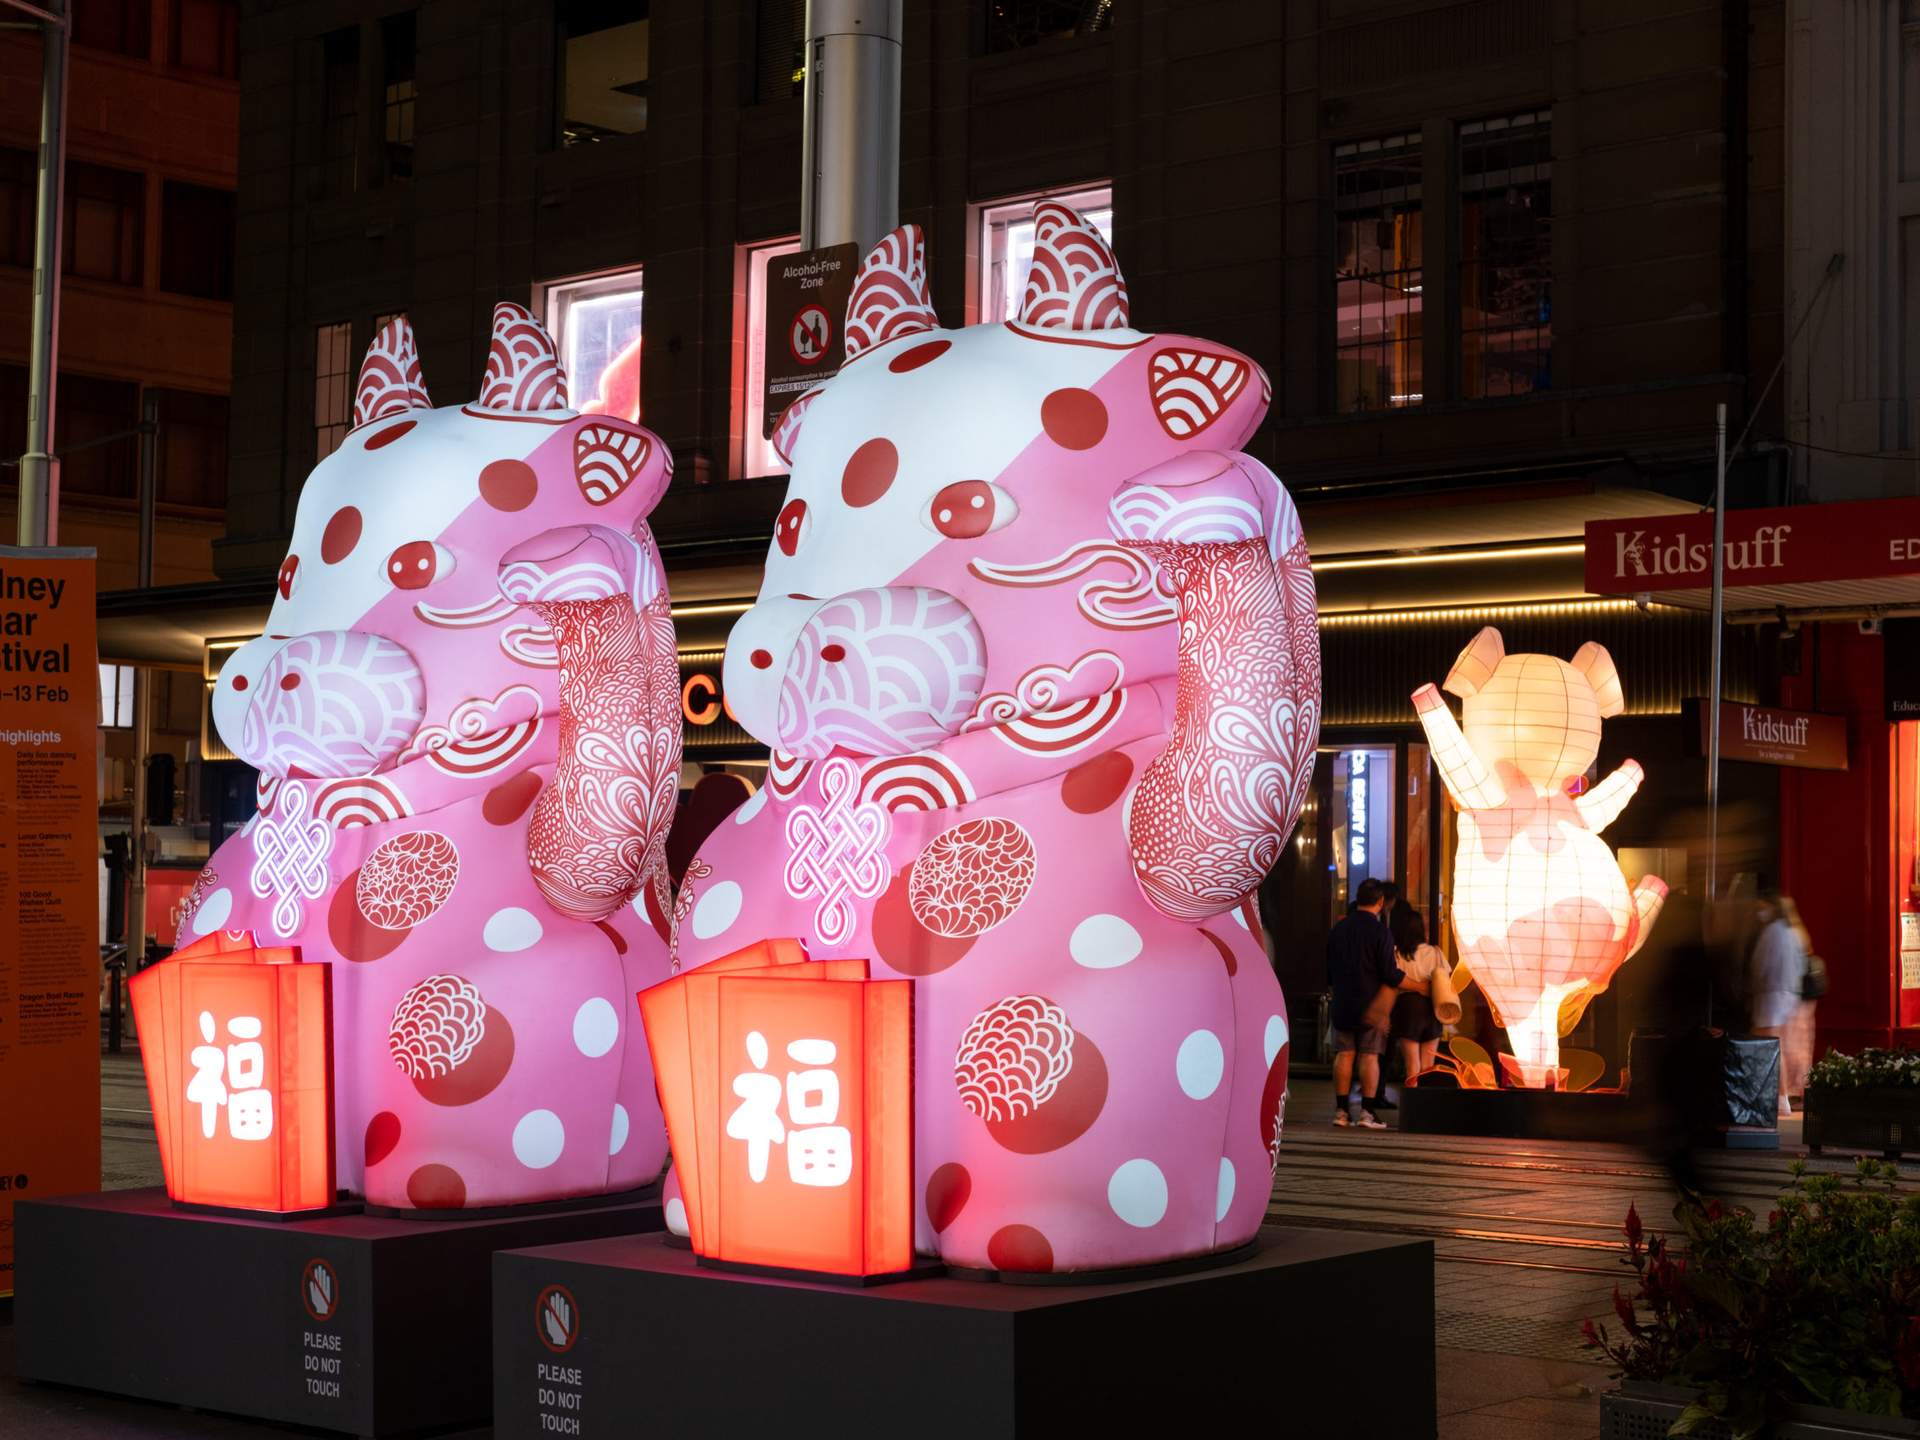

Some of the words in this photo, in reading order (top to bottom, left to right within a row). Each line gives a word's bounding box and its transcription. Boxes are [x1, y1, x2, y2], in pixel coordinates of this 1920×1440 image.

[783, 260, 841, 278] Alcohol-Free
[801, 276, 824, 289] Zone
[1614, 525, 1793, 579] Kidsuff
[0, 611, 38, 636] ar
[0, 642, 70, 673] tival
[36, 685, 70, 702] Feb
[682, 673, 738, 725] C
[1892, 699, 1920, 713] Educ
[0, 729, 62, 746] highlights
[1743, 707, 1809, 746] Kidstuff
[186, 1011, 273, 1141] 福
[726, 1031, 852, 1187] 福
[0, 1175, 13, 1192] EY
[304, 1332, 341, 1351] PLEASE
[305, 1355, 319, 1370] DO
[321, 1358, 341, 1375] NOT
[538, 1363, 582, 1386] PLEASE
[306, 1378, 340, 1398] TOUCH
[538, 1388, 555, 1406] DO
[558, 1391, 582, 1411] NOT
[540, 1413, 580, 1436] TOUCH
